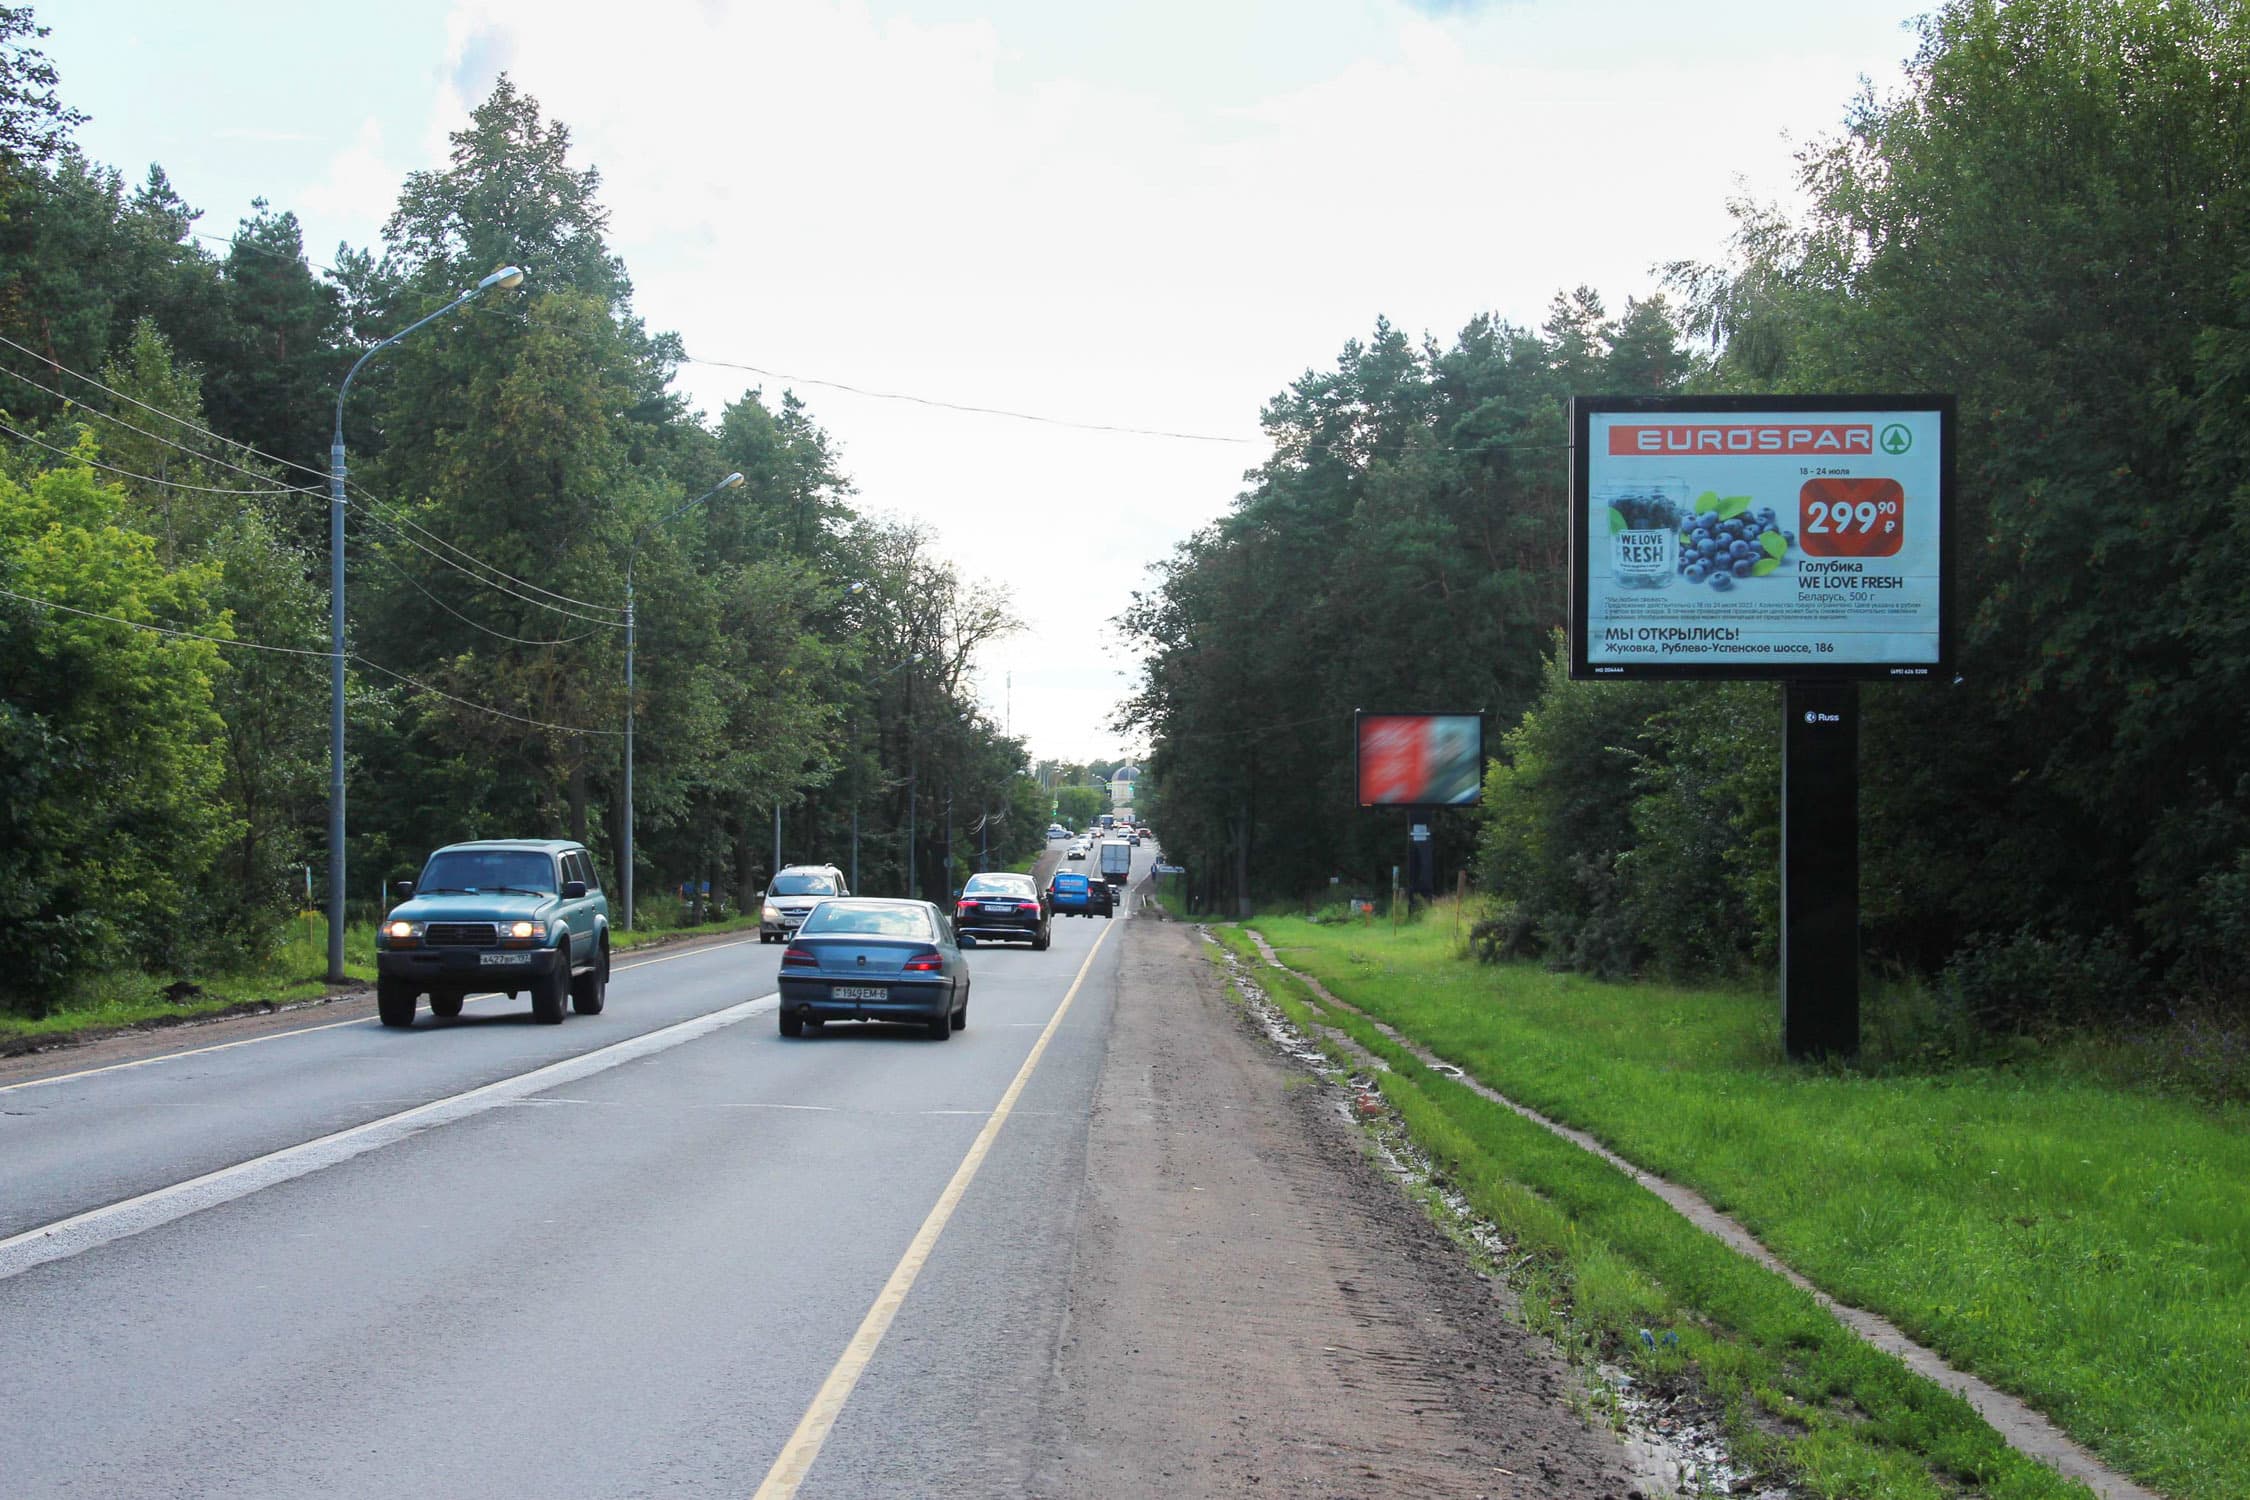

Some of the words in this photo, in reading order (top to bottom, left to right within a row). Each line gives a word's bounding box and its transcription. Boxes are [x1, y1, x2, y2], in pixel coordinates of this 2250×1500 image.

[1637, 429, 1870, 450] EUROSPAR
[1816, 467, 1826, 475] 24
[1807, 501, 1877, 534] 299
[1621, 534, 1637, 545] WE
[1639, 534, 1663, 545] LOVE
[1799, 560, 1863, 575] Голубика
[1799, 576, 1820, 589] WE
[1824, 576, 1858, 589] LOVE
[1861, 576, 1903, 589] FRESH
[1798, 592, 1845, 602] Беларусь,
[1850, 592, 1867, 601] 500
[1605, 628, 1633, 640] МЫ
[1638, 628, 1740, 640] ОТКРЫЛИСЬ!
[1605, 643, 1658, 654] Жуковка,
[1661, 643, 1770, 655] Рублево-Успенское
[1774, 644, 1812, 653] шоссе,
[1816, 643, 1834, 652] 186
[1818, 713, 1840, 722] Russ
